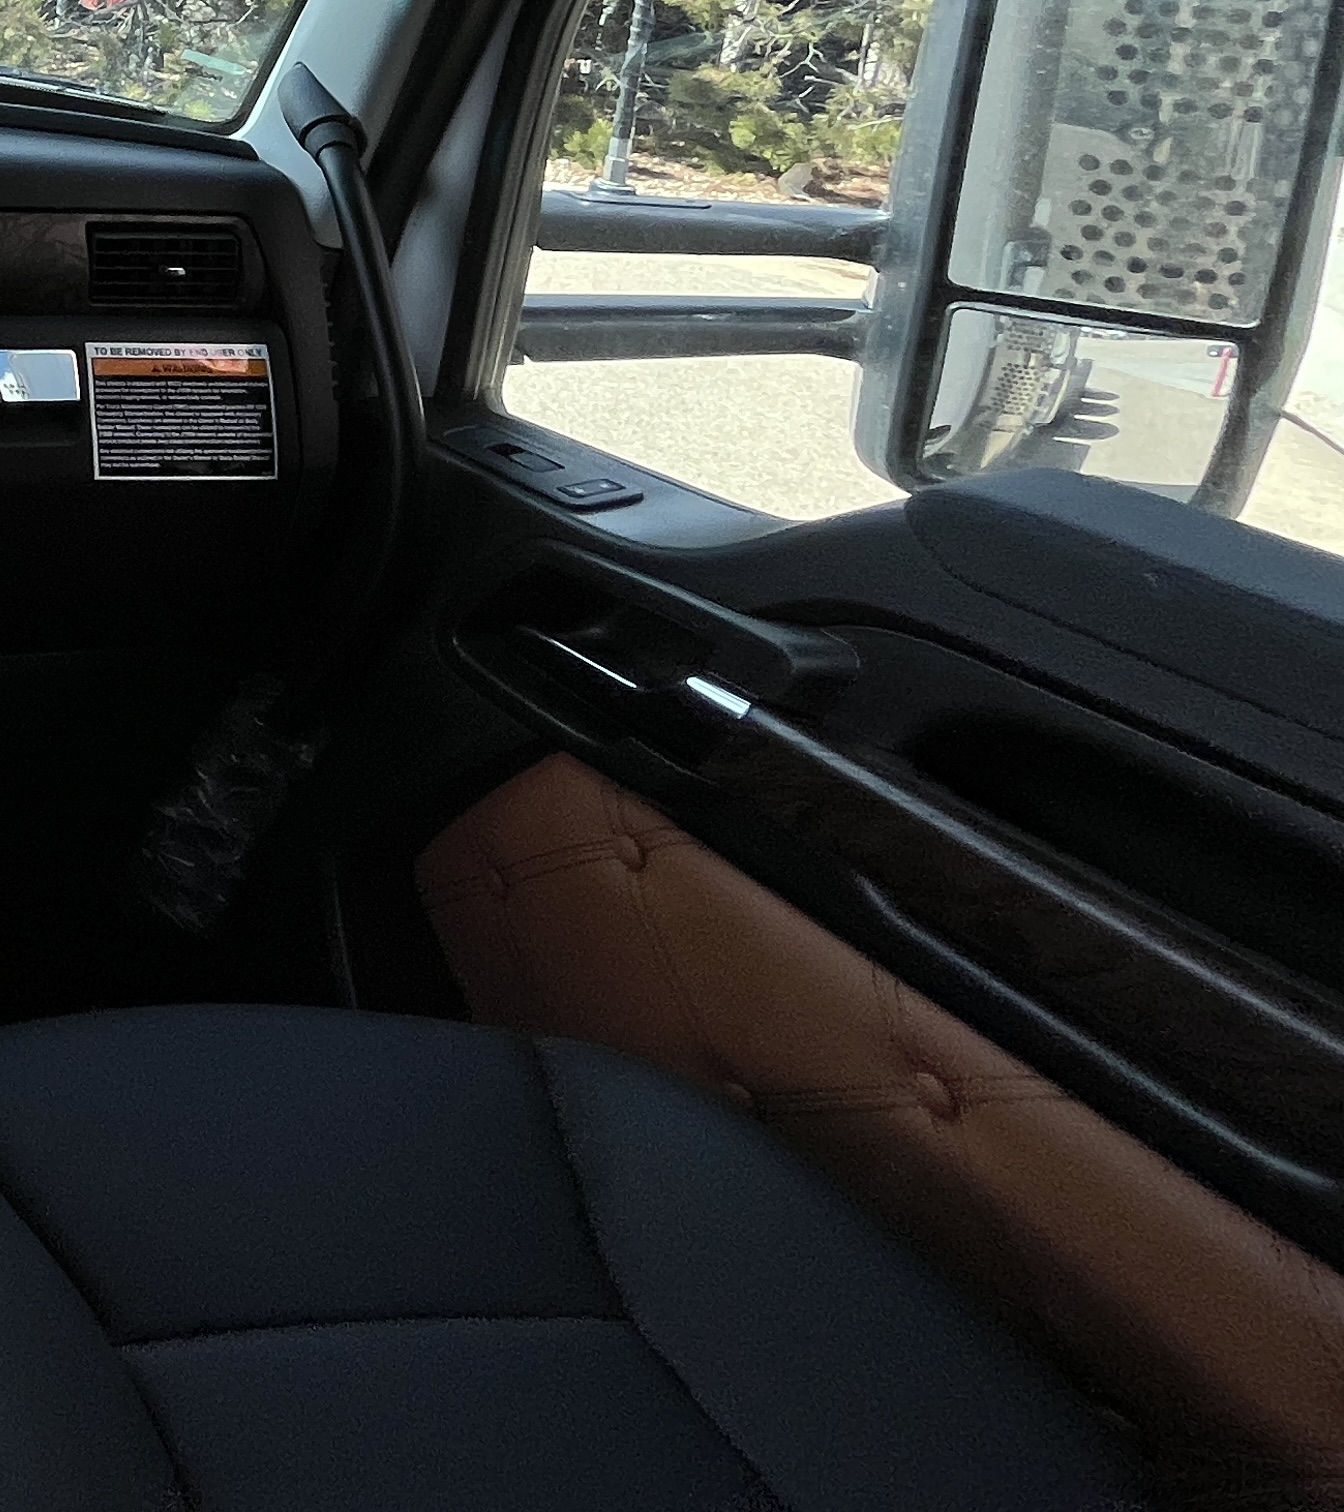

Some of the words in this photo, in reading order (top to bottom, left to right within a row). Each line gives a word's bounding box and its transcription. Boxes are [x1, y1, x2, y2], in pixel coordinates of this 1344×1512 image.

[94, 347, 108, 356] TO
[110, 348, 123, 356] BE
[125, 348, 172, 356] REMOVED
